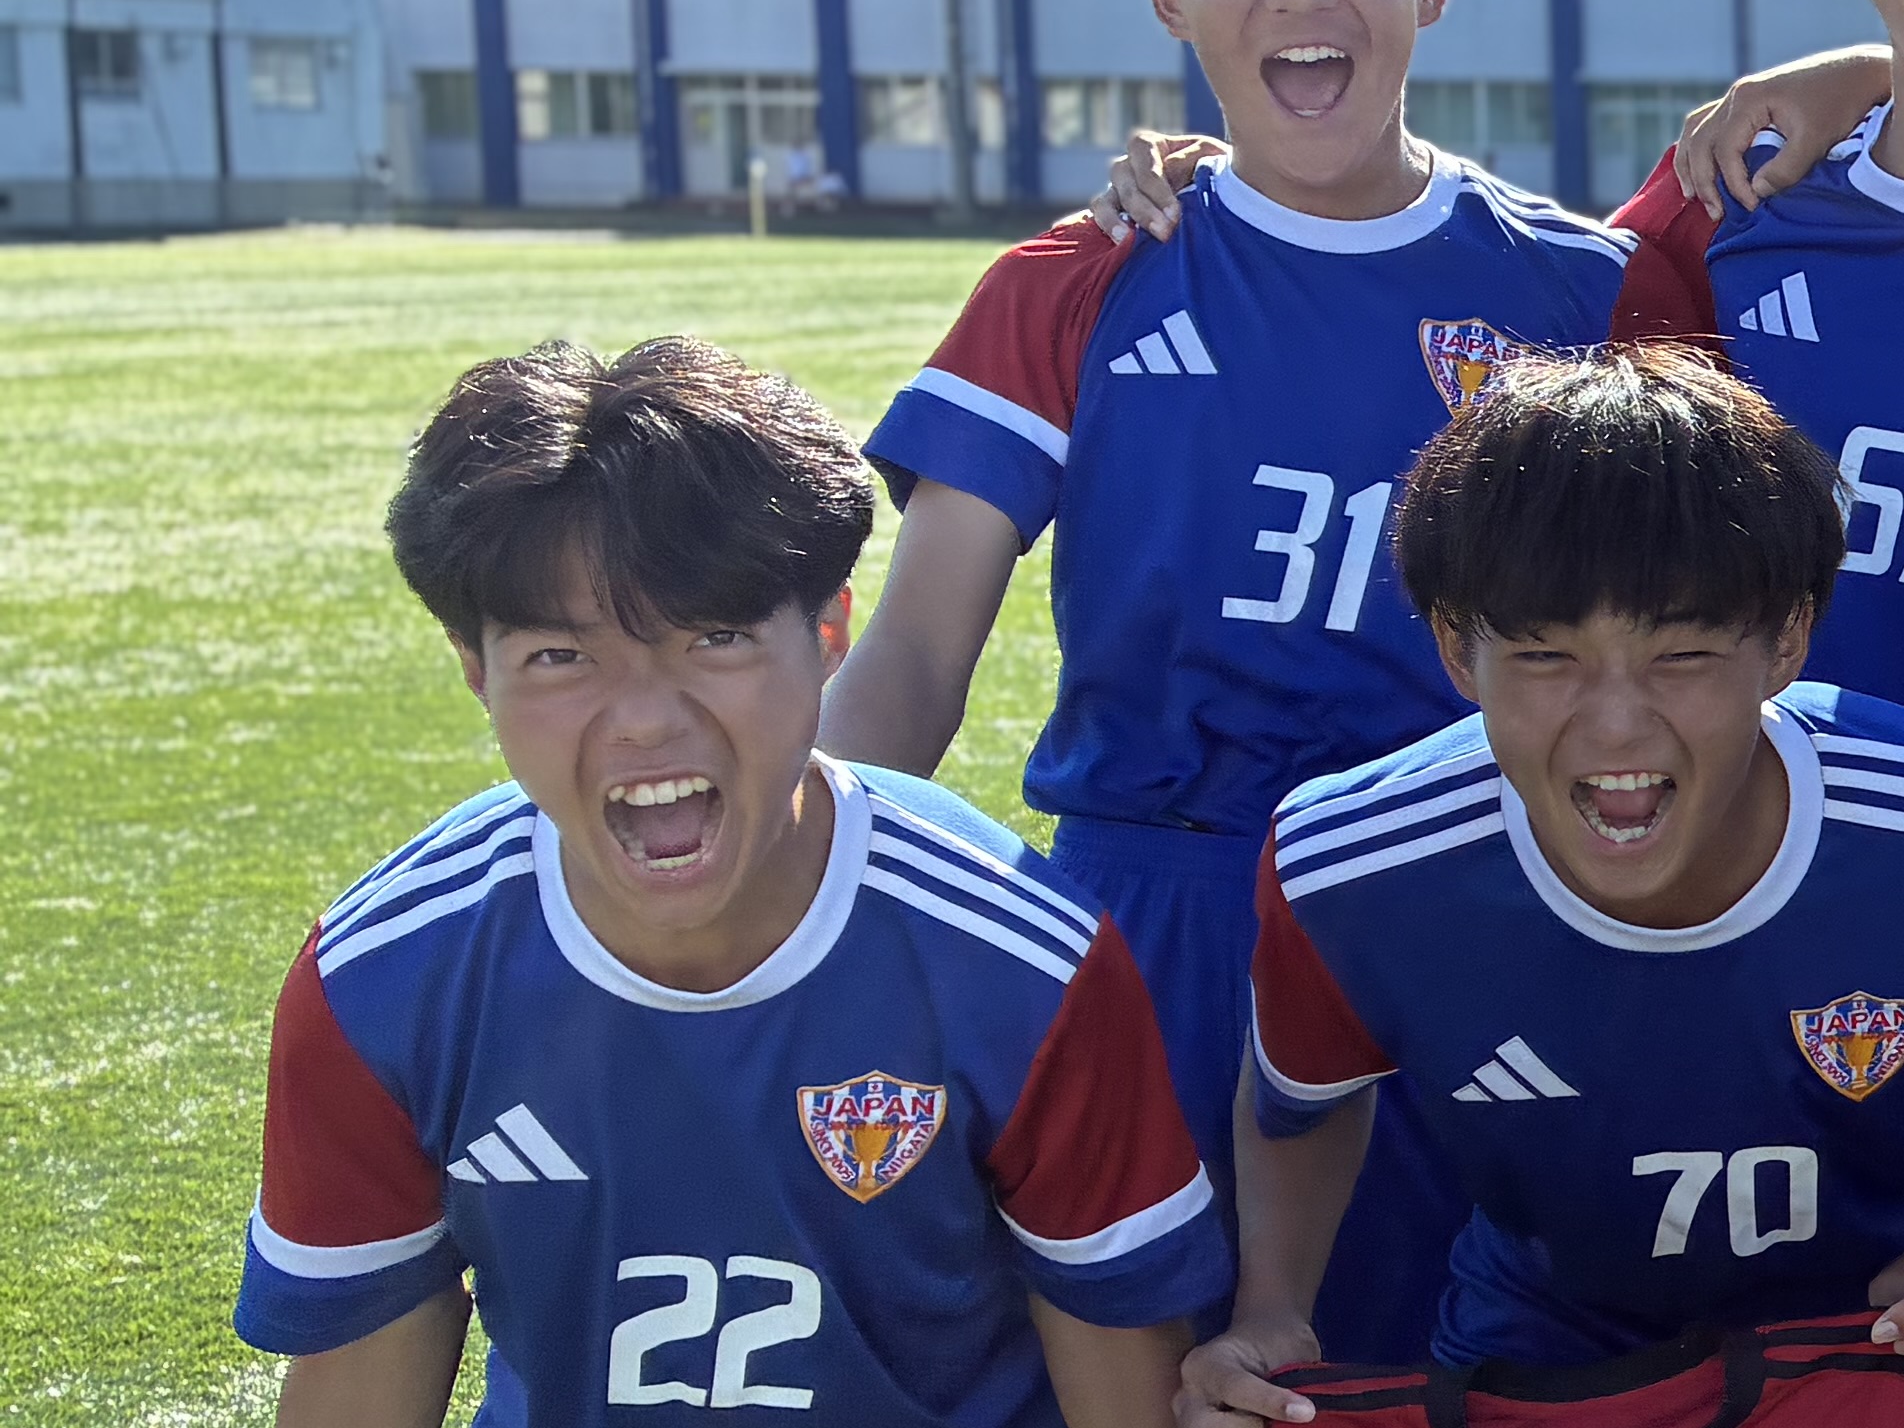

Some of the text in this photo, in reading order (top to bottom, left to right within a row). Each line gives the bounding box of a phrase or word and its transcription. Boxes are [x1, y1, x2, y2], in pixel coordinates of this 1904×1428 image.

[1222, 464, 1393, 632] 31
[813, 1095, 934, 1117] JAPAN
[881, 1123, 934, 1181] NIIGATA
[1632, 1146, 1819, 1258] 70
[608, 1256, 821, 1410] 22
